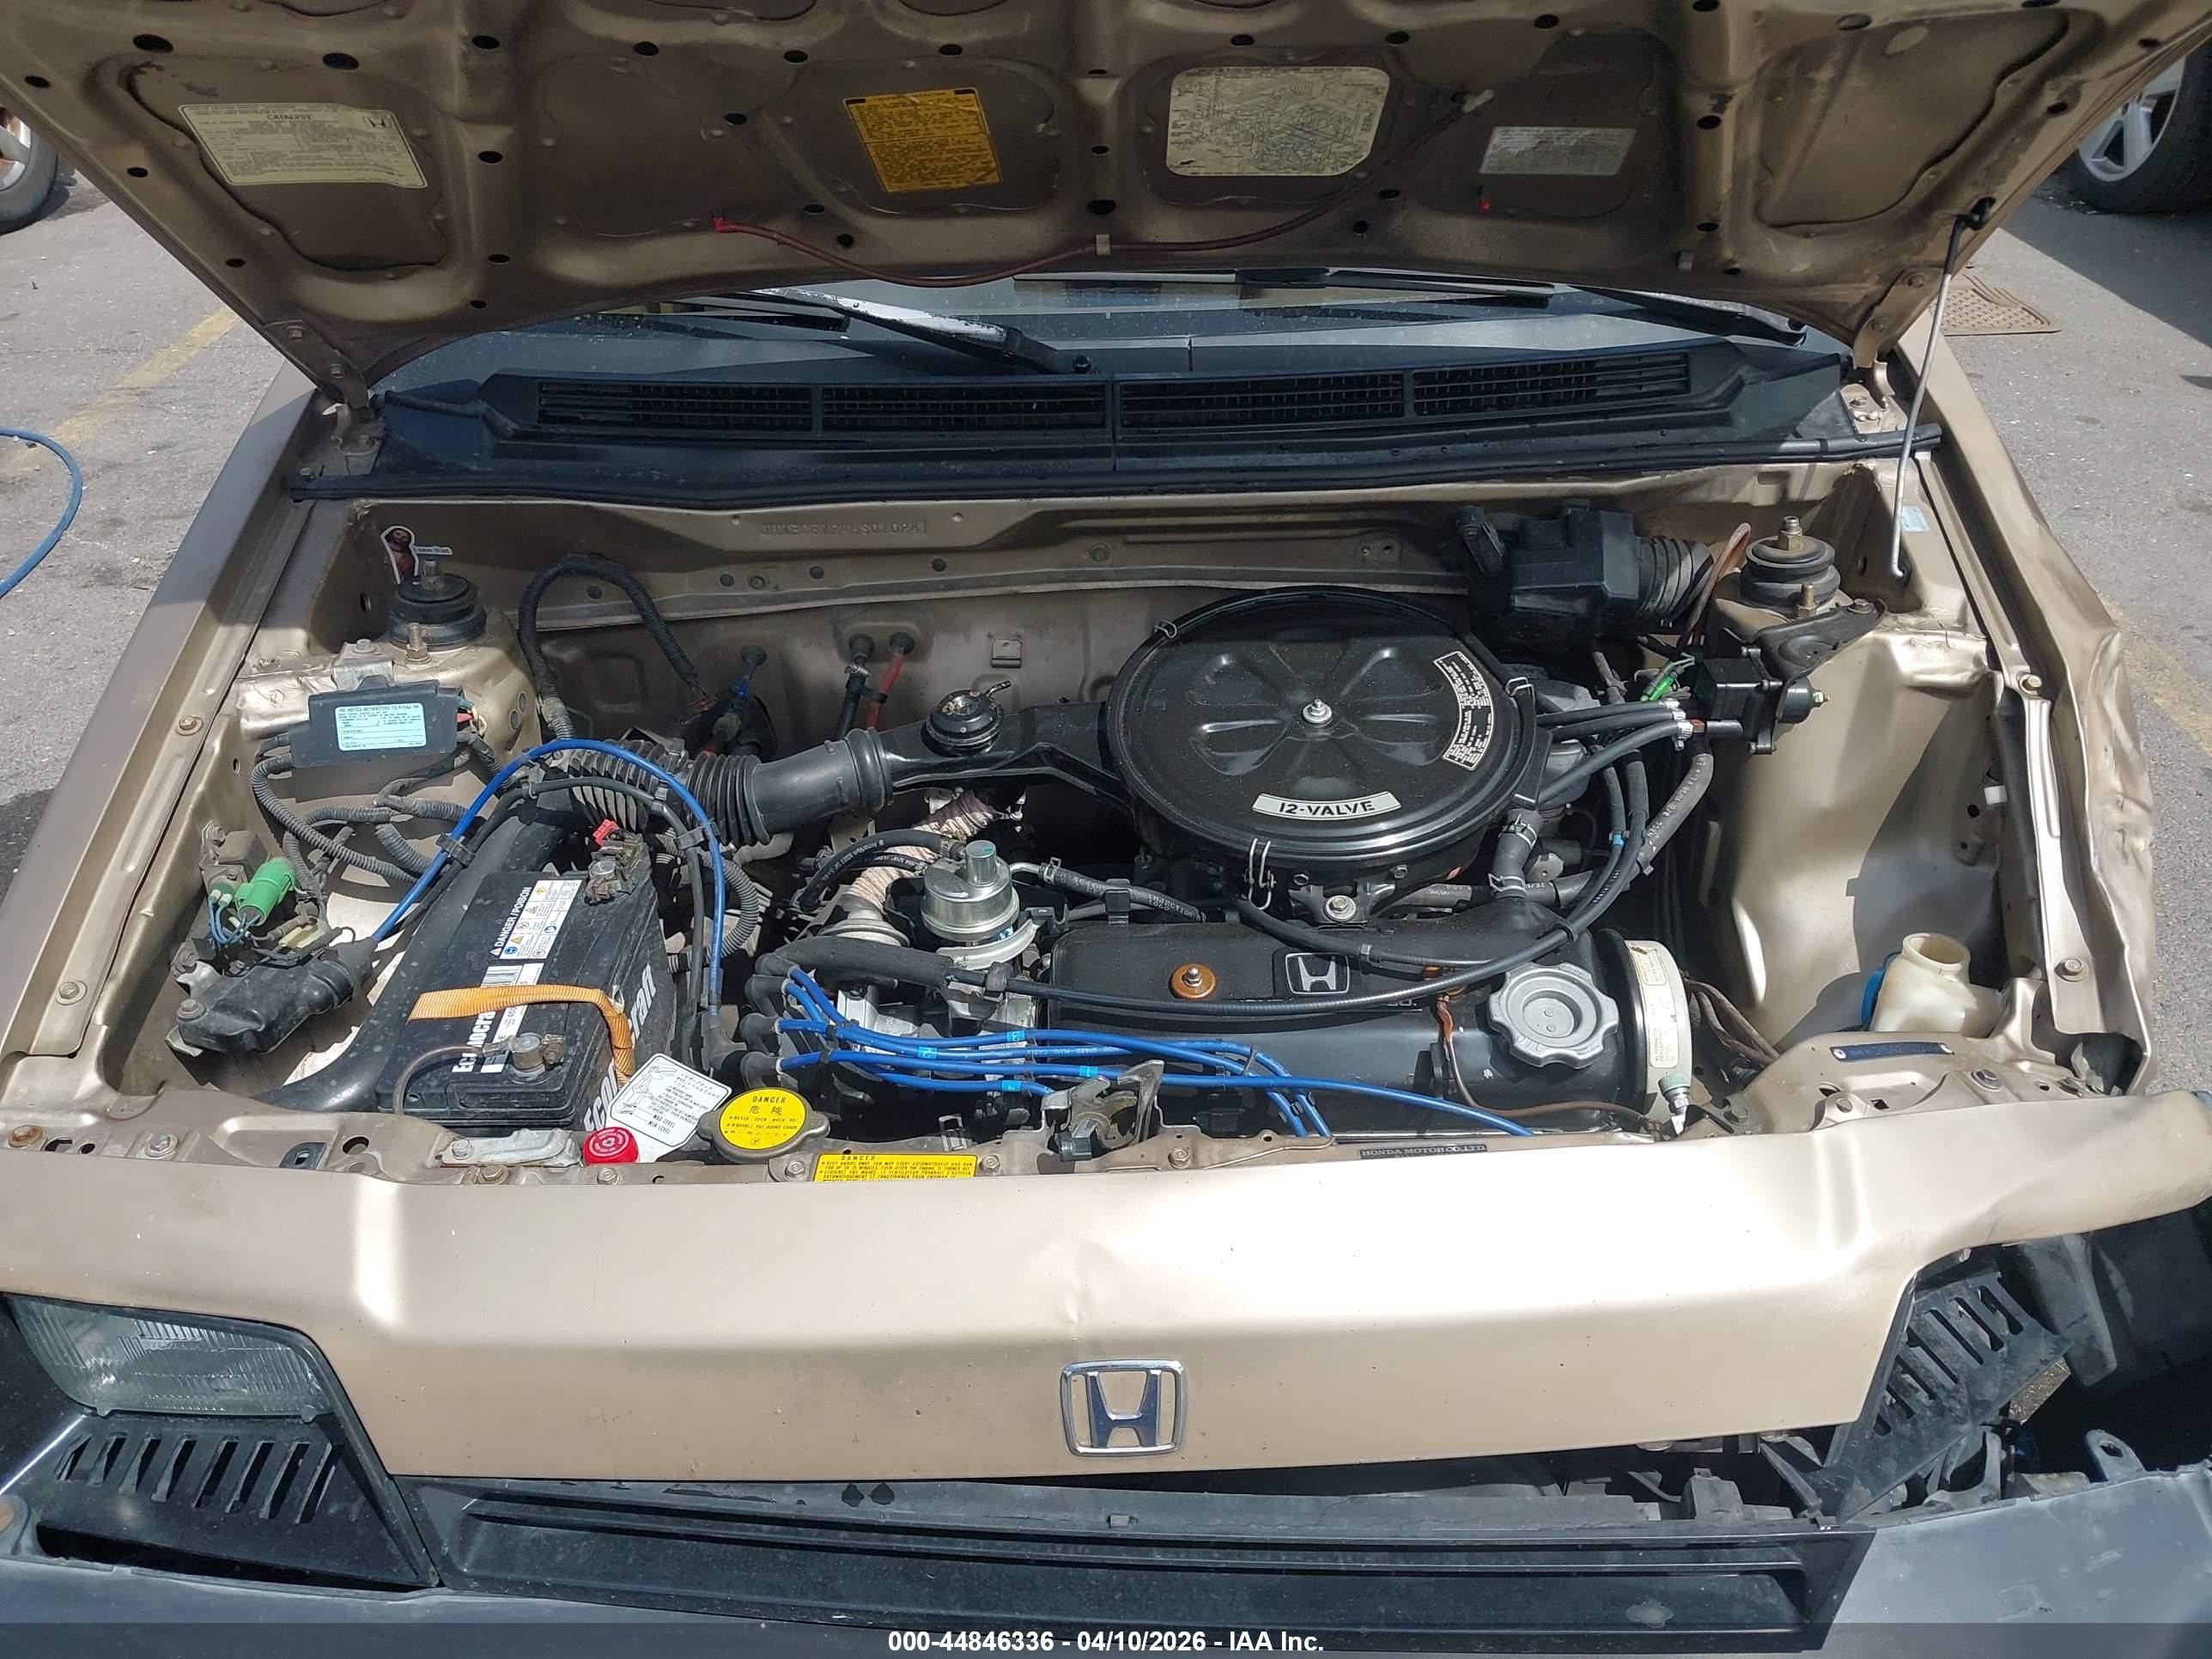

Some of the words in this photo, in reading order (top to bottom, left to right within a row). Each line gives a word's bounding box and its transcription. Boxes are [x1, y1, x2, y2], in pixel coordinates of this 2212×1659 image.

[1279, 800, 1375, 817] 12-VALVE
[495, 915, 515, 946] DANGER
[1516, 1036, 1543, 1053] OIL
[652, 1113, 663, 1121] MAX
[647, 1121, 659, 1129] MIN
[1361, 1148, 1401, 1157] HONDA
